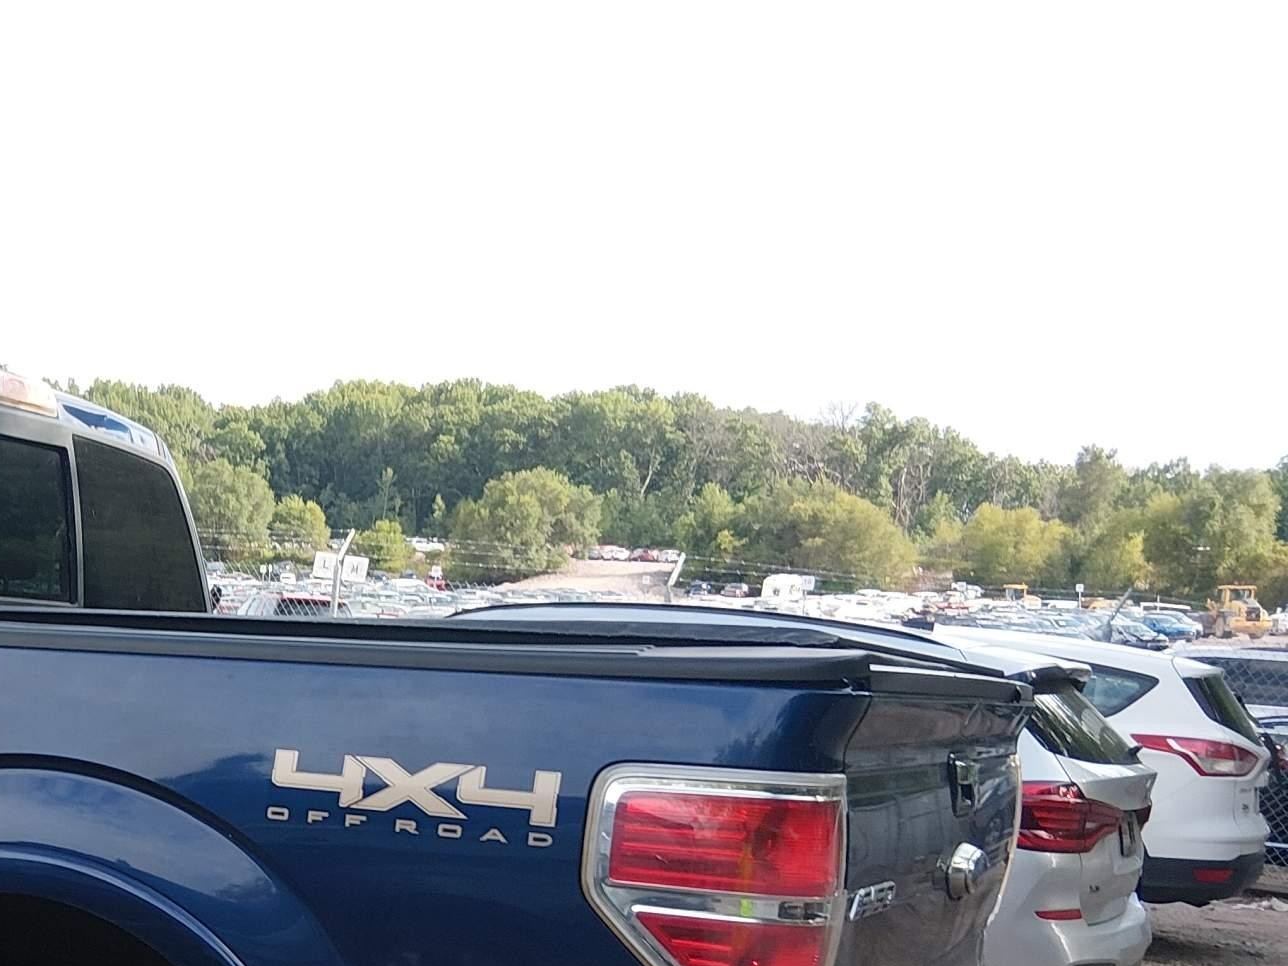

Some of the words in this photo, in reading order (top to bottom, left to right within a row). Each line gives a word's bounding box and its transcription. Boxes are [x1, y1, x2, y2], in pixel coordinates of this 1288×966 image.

[271, 748, 562, 828] 4X4
[267, 806, 368, 828] OFF
[395, 819, 553, 848] ROAD
